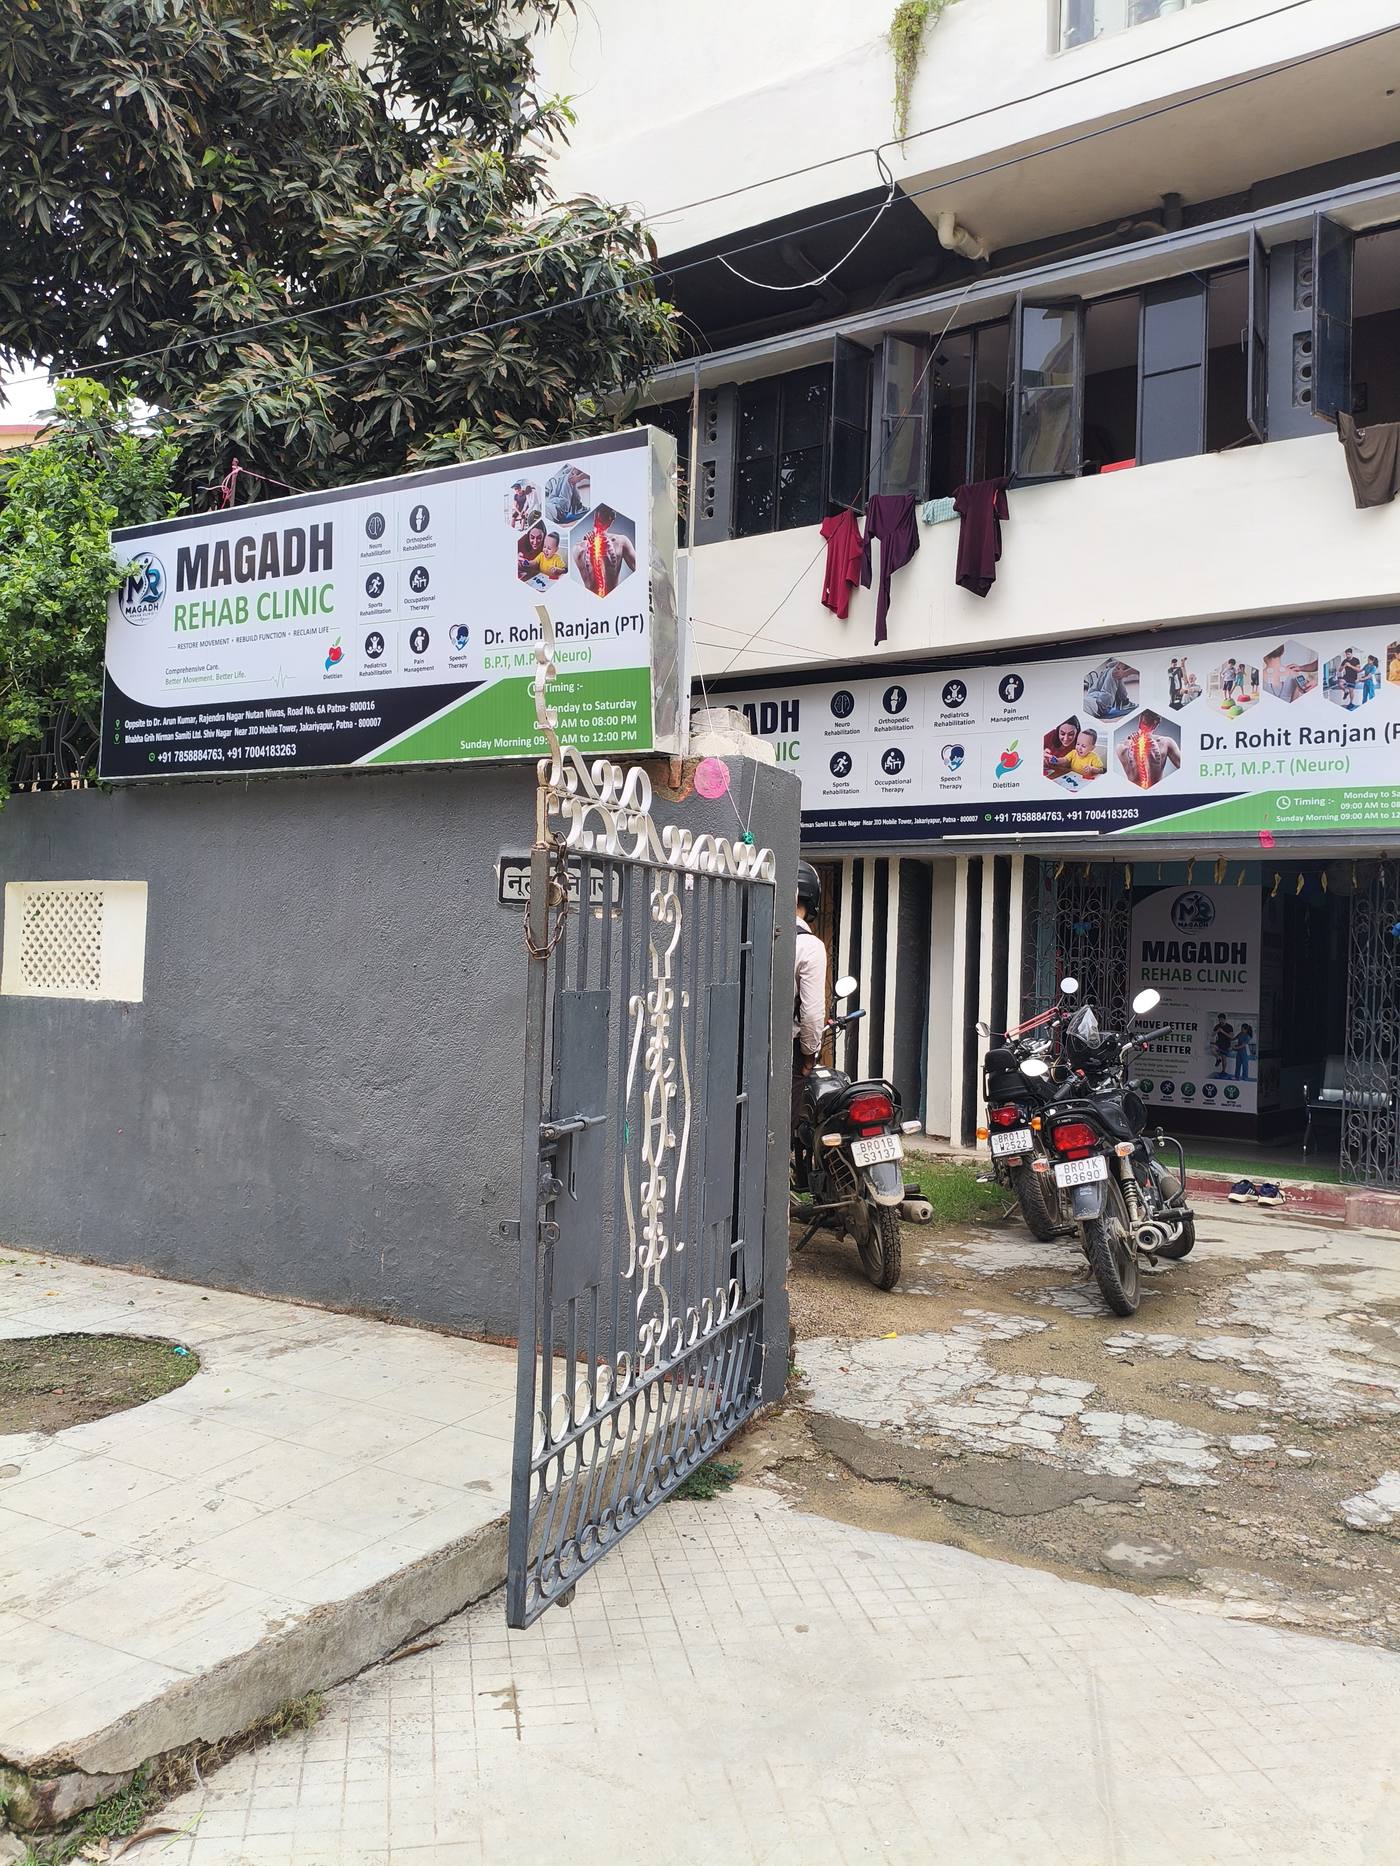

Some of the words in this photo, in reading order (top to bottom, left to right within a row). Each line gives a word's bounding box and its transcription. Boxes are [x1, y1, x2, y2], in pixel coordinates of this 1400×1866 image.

[406, 535, 432, 544] Orthopedic
[360, 549, 391, 558] Rehabilitation
[403, 542, 436, 552] Rehabilitation
[176, 522, 333, 592] MAGADH
[404, 595, 435, 604] Occupational
[126, 603, 158, 614] MAGADH
[174, 596, 249, 631] REHAB
[257, 584, 334, 621] CLINIC
[360, 608, 391, 617] Rehabilitation
[410, 604, 430, 612] Therapy
[484, 629, 503, 645] Dr.
[510, 623, 544, 642] Rohi
[555, 619, 609, 639] Ranjan
[616, 613, 644, 635] (PT)
[200, 638, 230, 647] MOVEMENT
[259, 632, 286, 641] FUNCTION
[294, 628, 317, 636] RECLAIM
[484, 655, 511, 670] B.P.T,
[514, 653, 535, 666] M.P.
[554, 647, 592, 662] Neuro)
[166, 665, 205, 675] Comprehensive
[359, 669, 392, 677] Rehabilitation
[166, 677, 181, 685] Better
[183, 674, 214, 684] Movement.
[216, 672, 233, 680] Better
[234, 671, 246, 679] Life.
[545, 682, 575, 692] Timing
[583, 702, 592, 711] to
[595, 700, 637, 710] Saturday
[125, 720, 145, 730] Oppsite
[147, 718, 152, 727] to
[163, 717, 176, 726] Arun
[178, 716, 198, 725] Kumar,
[199, 713, 225, 723] Rajendra
[227, 712, 244, 722] Nagar
[246, 711, 264, 719] Nutan
[265, 709, 285, 718] Niwas,
[287, 707, 303, 716] Road
[305, 706, 315, 715] No.
[317, 705, 326, 714] 6A
[327, 704, 348, 713] Patna-
[350, 701, 375, 712] 800016
[561, 718, 577, 728] AM
[580, 717, 589, 727] to
[592, 716, 618, 726] 08:00
[621, 715, 637, 725] PM
[991, 715, 1029, 723] Management
[934, 719, 975, 727] Rehabilitation
[125, 735, 143, 743] Bhabha
[144, 733, 154, 743] Grih
[156, 732, 174, 742] Nirman
[175, 731, 191, 740] Samiti
[193, 730, 201, 739] Ltd.
[203, 729, 214, 738] Shiv
[216, 728, 232, 739] Nagar
[235, 728, 247, 736] Near
[259, 724, 278, 735] Mobile
[279, 723, 298, 733] Tower,
[299, 721, 335, 732] Jakariyapur,
[336, 720, 353, 729] Patna
[359, 718, 381, 728] 800007
[1200, 733, 1227, 750] Dr.
[1235, 729, 1291, 748] Rohit
[1299, 724, 1376, 747] Ranjan
[1384, 722, 1400, 744] (P
[460, 738, 492, 750] Sunday
[494, 736, 531, 750] Morning
[562, 734, 577, 744] AM
[580, 733, 589, 742] to
[592, 732, 618, 742] 12:00
[621, 731, 637, 741] PM
[158, 752, 171, 762] +91
[175, 749, 224, 762] 7858884763,
[227, 747, 241, 759] +91
[245, 744, 296, 758] 7004183263
[1200, 763, 1236, 778] B.P.T,
[1242, 760, 1285, 776] M.P.T
[1290, 756, 1350, 776] (Neuro)
[1294, 798, 1326, 806] Timing
[914, 817, 942, 825] Jakariyapur,
[994, 814, 1008, 822] +91
[1012, 812, 1064, 822] 7858884763,
[1067, 810, 1082, 820] +91
[1085, 809, 1139, 819] 7004183263
[1142, 941, 1247, 964] MAGADH
[1141, 968, 1192, 981] REHAB
[1197, 969, 1247, 983] CLINIC
[1135, 1020, 1161, 1029] MOVE
[1157, 1044, 1191, 1054] BETTER
[998, 1133, 1025, 1143] BR01J
[860, 1138, 893, 1152] BR01B
[1001, 1140, 1027, 1151] W2522
[864, 1148, 895, 1162] S3137
[1063, 1161, 1098, 1174] BR01K
[1065, 1170, 1100, 1184] B3690
